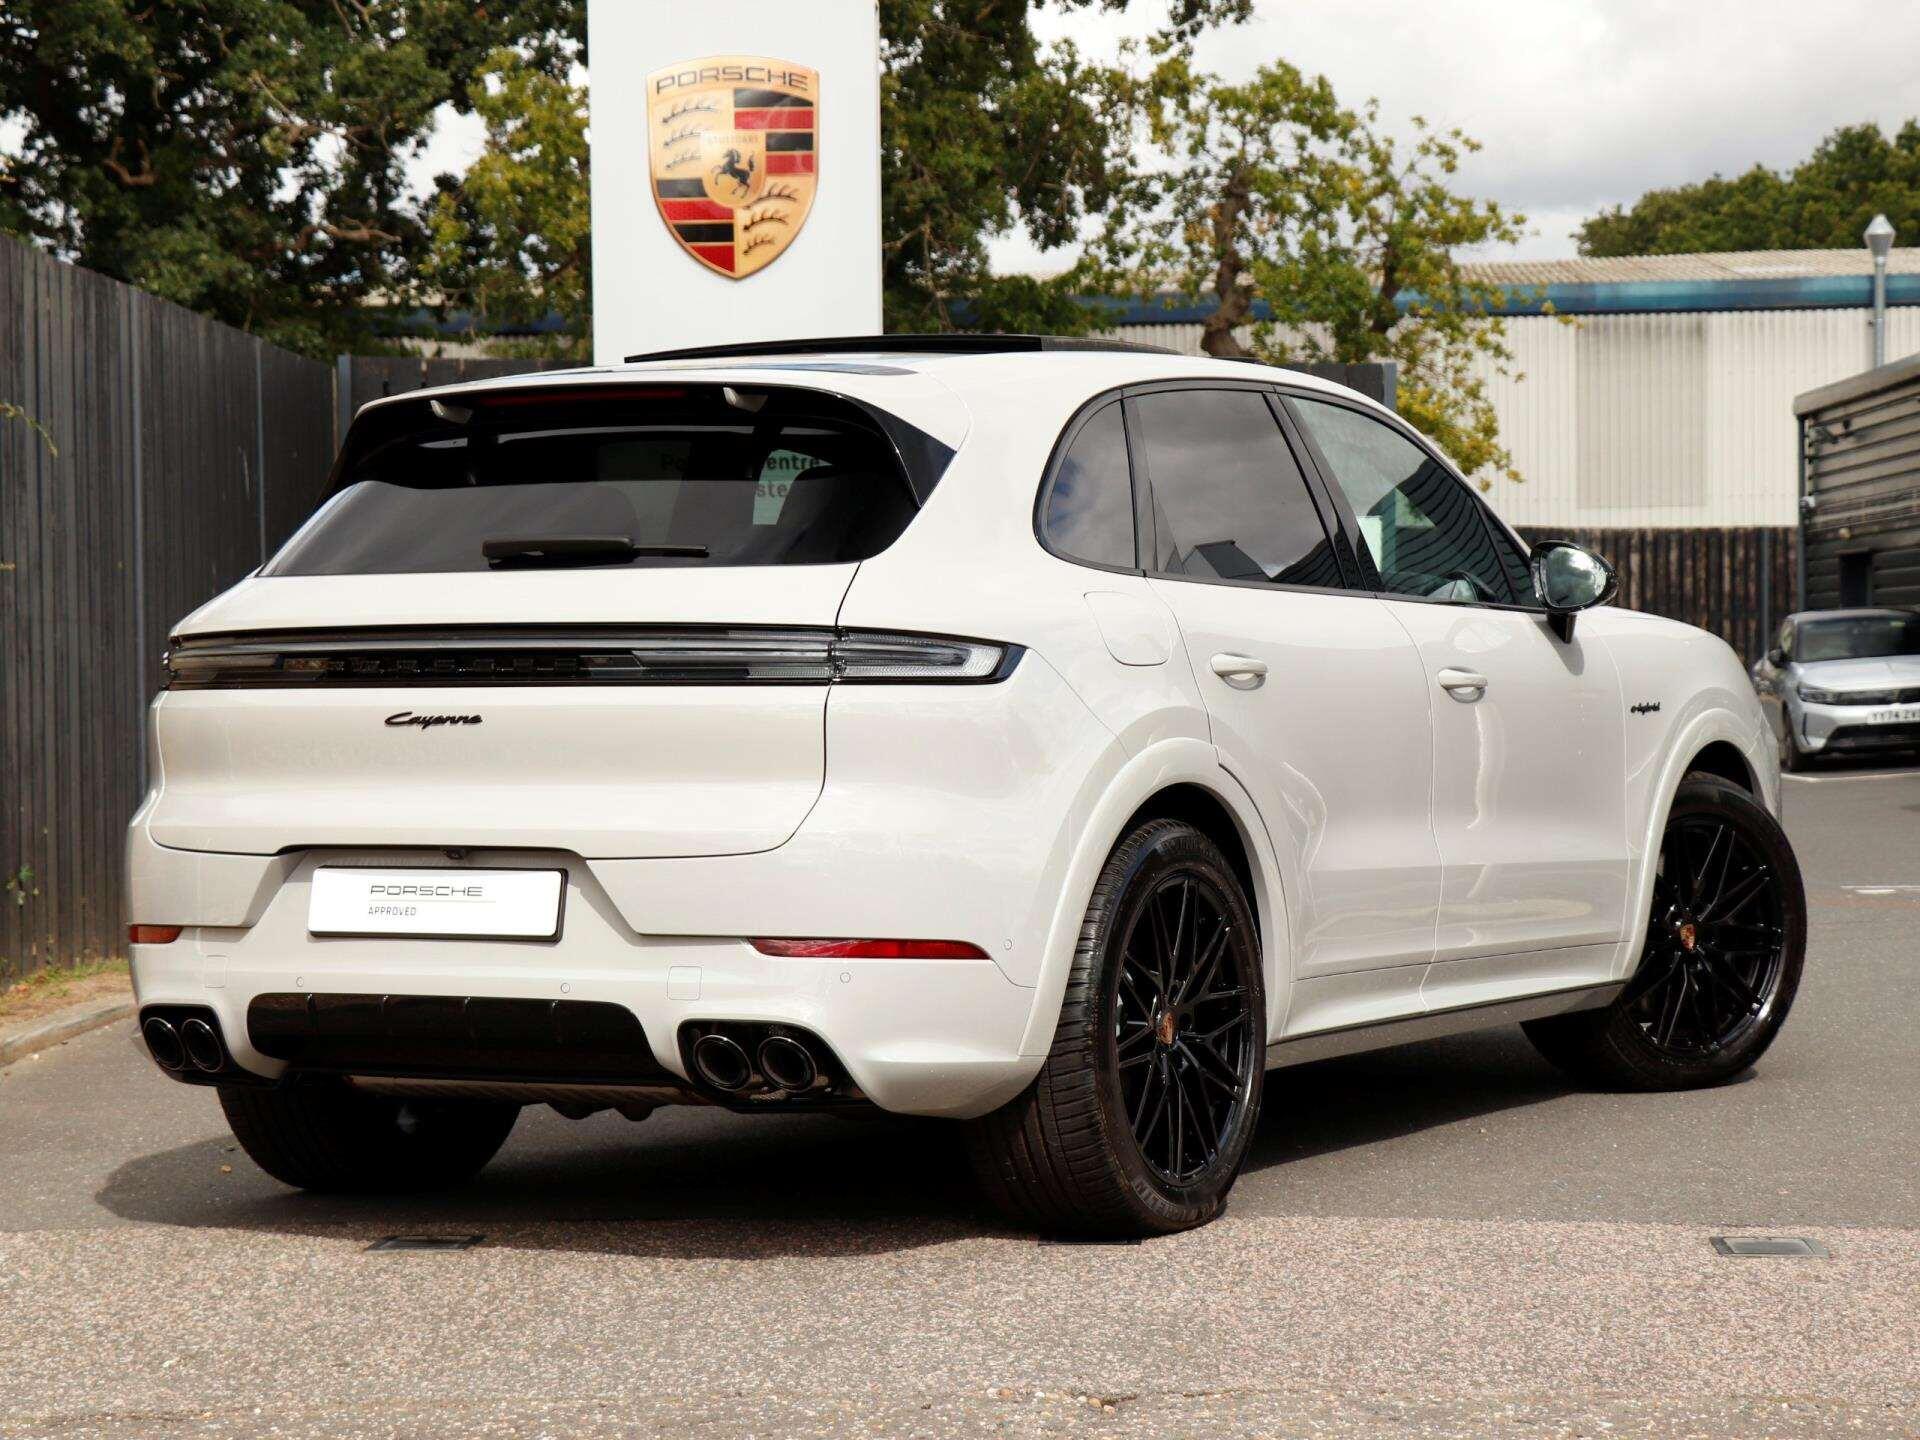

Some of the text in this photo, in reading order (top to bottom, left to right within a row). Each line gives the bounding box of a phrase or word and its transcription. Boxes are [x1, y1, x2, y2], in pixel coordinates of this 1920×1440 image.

[656, 66, 808, 94] PORSCHE
[385, 711, 482, 729] Cayenne
[370, 885, 483, 897] PORSCHE
[368, 906, 417, 916] APPROVED
